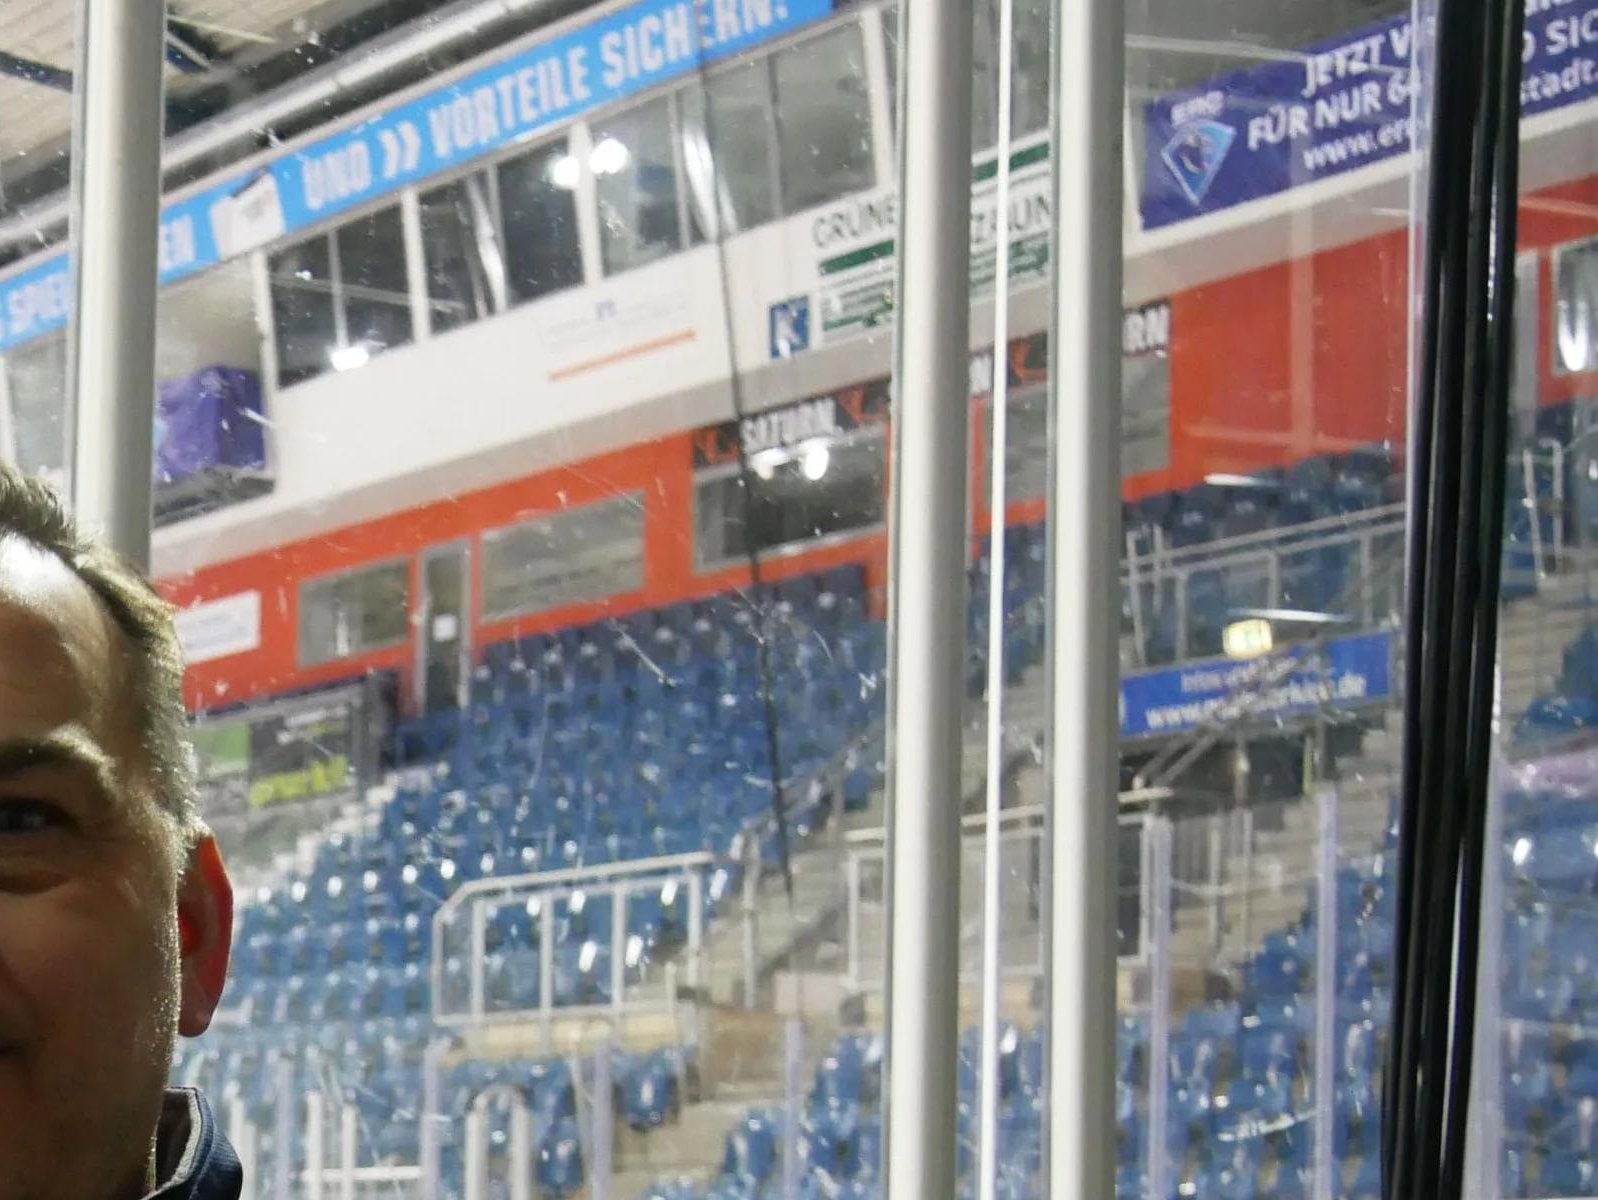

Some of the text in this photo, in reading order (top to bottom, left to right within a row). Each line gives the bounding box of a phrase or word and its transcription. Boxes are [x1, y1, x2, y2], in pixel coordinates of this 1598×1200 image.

[1301, 33, 1386, 98] JETZT
[302, 141, 371, 211] UND
[428, 47, 591, 158] VORTEILE
[1247, 104, 1310, 152] FÜR
[1313, 80, 1383, 130] NUR
